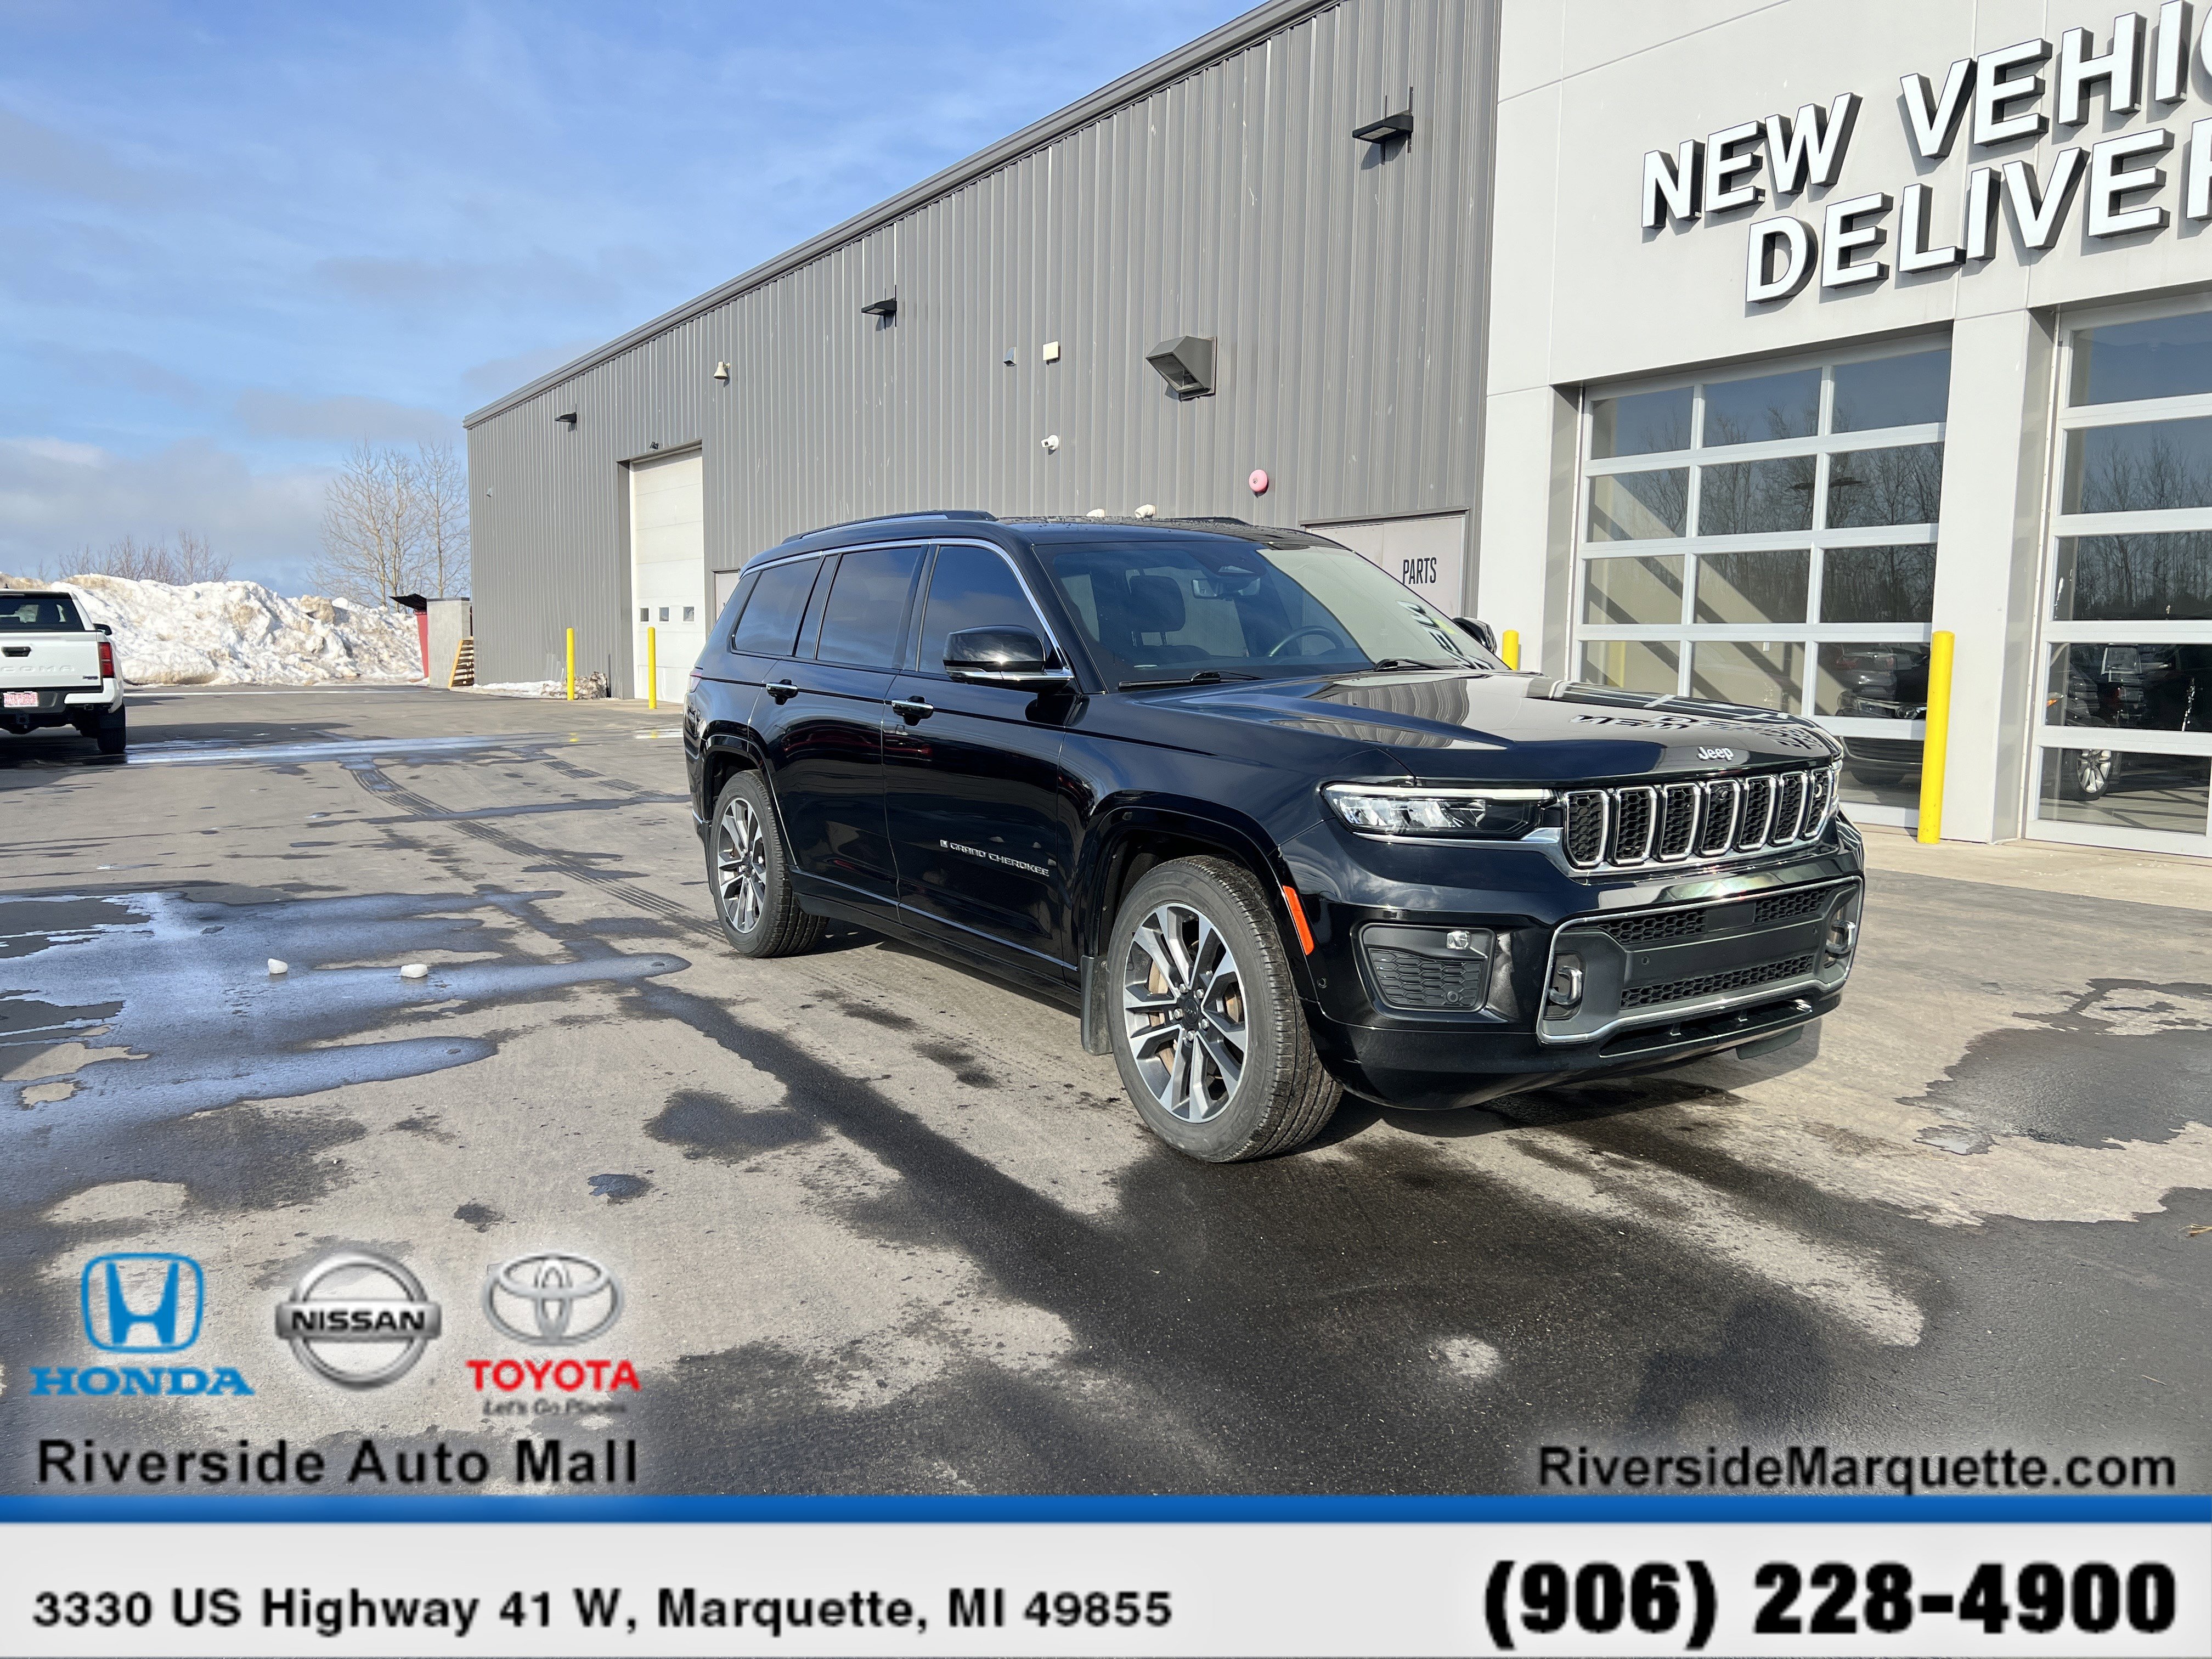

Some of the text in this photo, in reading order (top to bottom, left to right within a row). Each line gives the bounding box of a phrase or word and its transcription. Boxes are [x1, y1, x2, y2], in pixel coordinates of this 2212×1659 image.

[1642, 0, 2212, 228] NEW VEHI
[1402, 557, 1436, 584] PARTS
[1696, 746, 1734, 761] Jeep
[950, 842, 1049, 877] GRAND CHEROKEE
